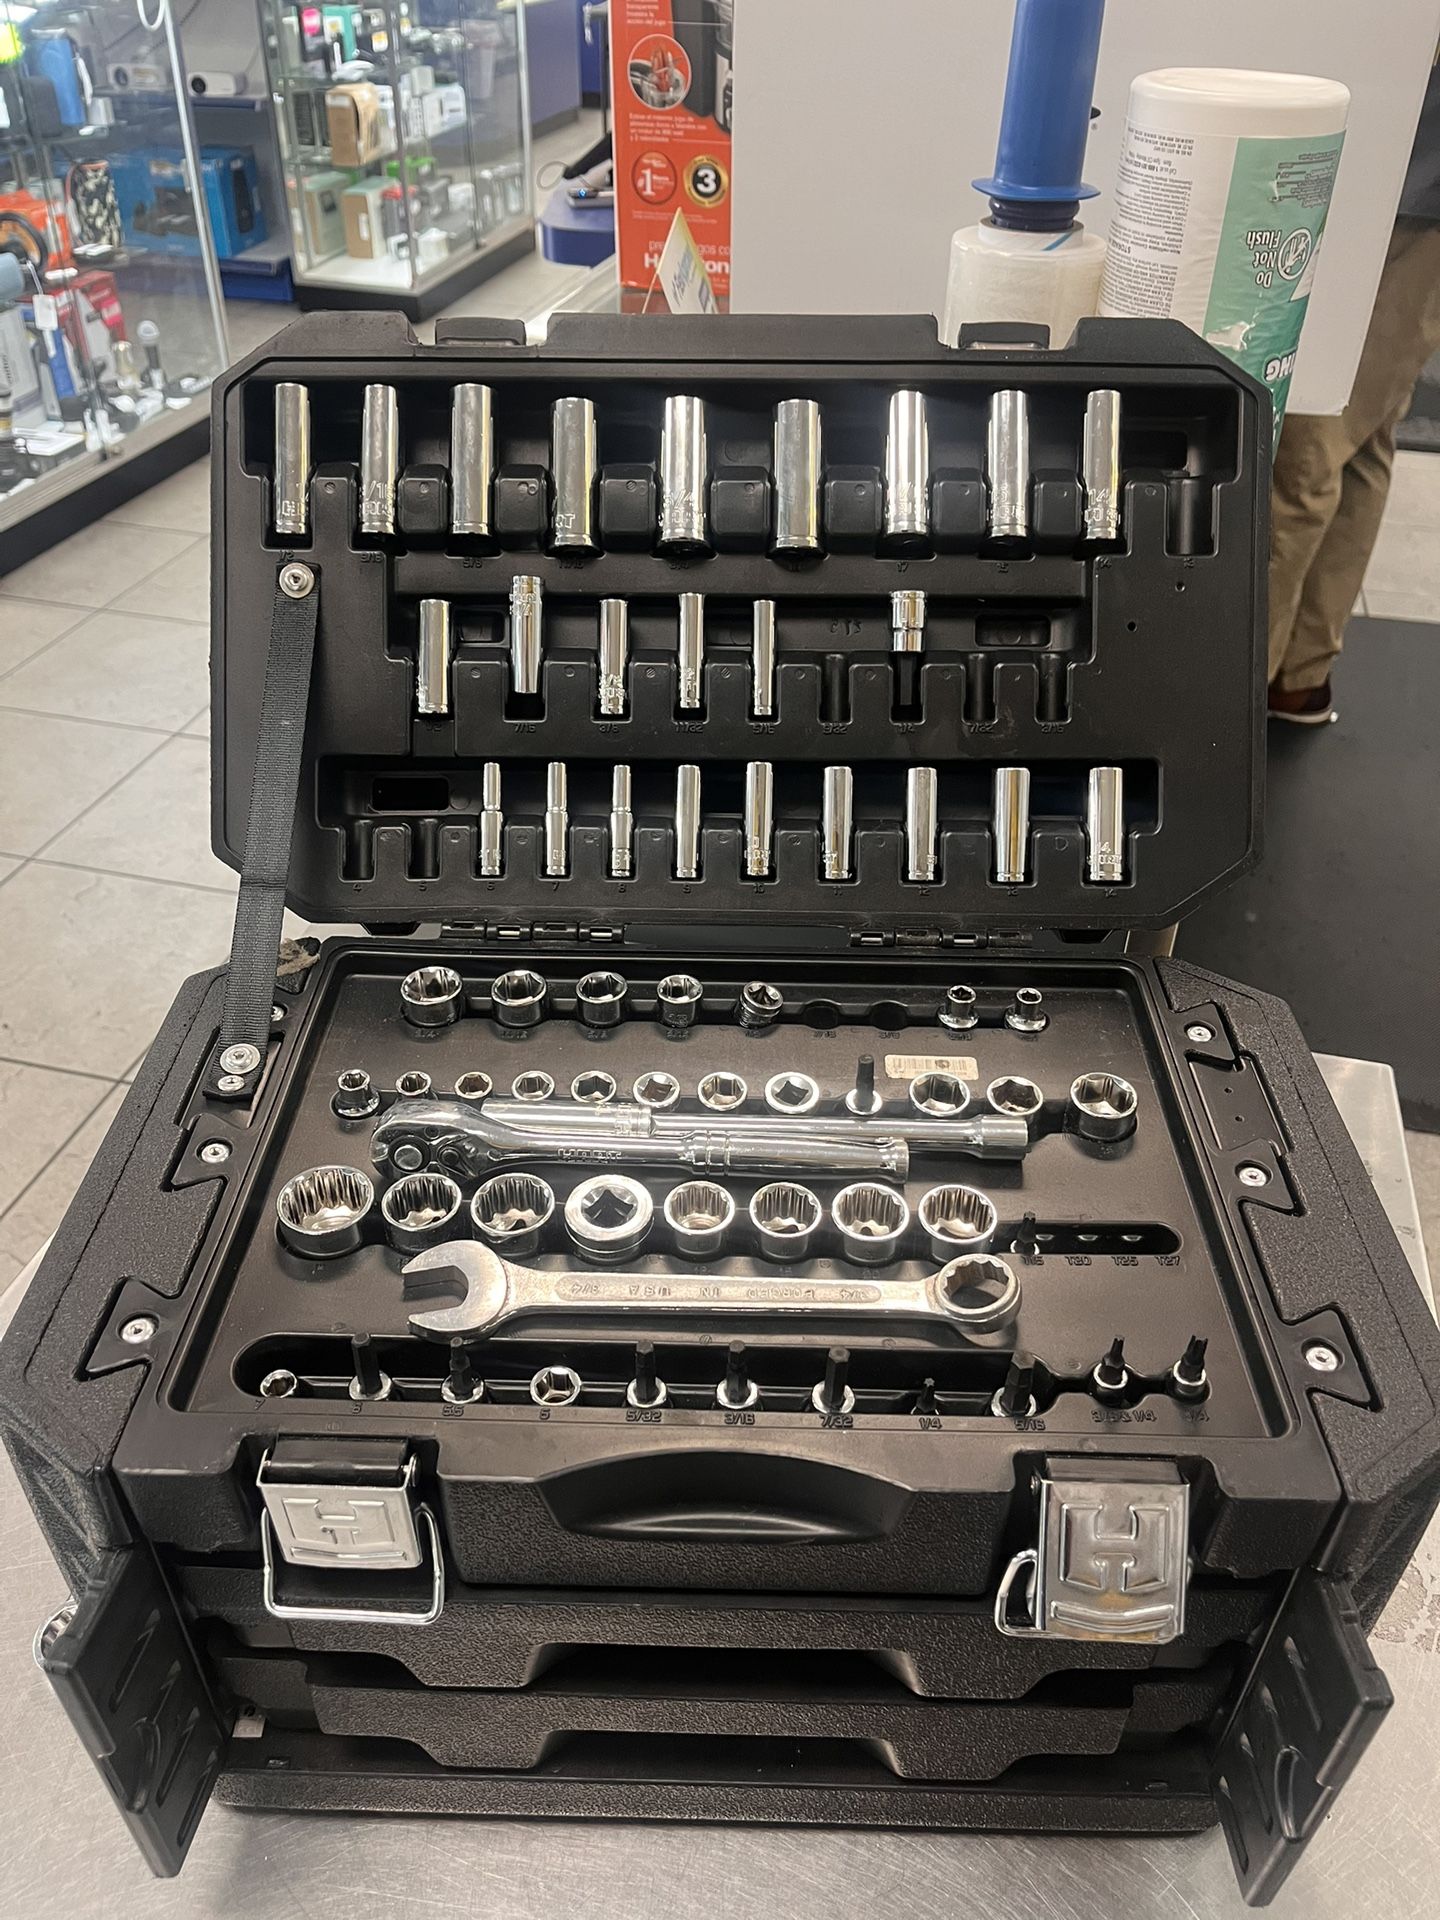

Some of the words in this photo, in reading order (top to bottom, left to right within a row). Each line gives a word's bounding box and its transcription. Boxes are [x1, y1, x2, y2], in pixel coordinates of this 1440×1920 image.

[696, 168, 718, 194] 3
[1246, 231, 1282, 250] Flush
[1253, 250, 1278, 268] Not
[1256, 271, 1273, 289] Do
[1066, 1256, 1093, 1266] T20
[1111, 1255, 1140, 1266] T25
[1155, 1255, 1181, 1266] T27
[699, 1286, 720, 1298] IN
[746, 1287, 815, 1299] FORGED
[625, 1410, 662, 1423] 5/32
[724, 1412, 756, 1425] 3/16
[820, 1415, 854, 1428] 7/32
[919, 1416, 943, 1430] 1/4
[1014, 1418, 1047, 1431] 5/16
